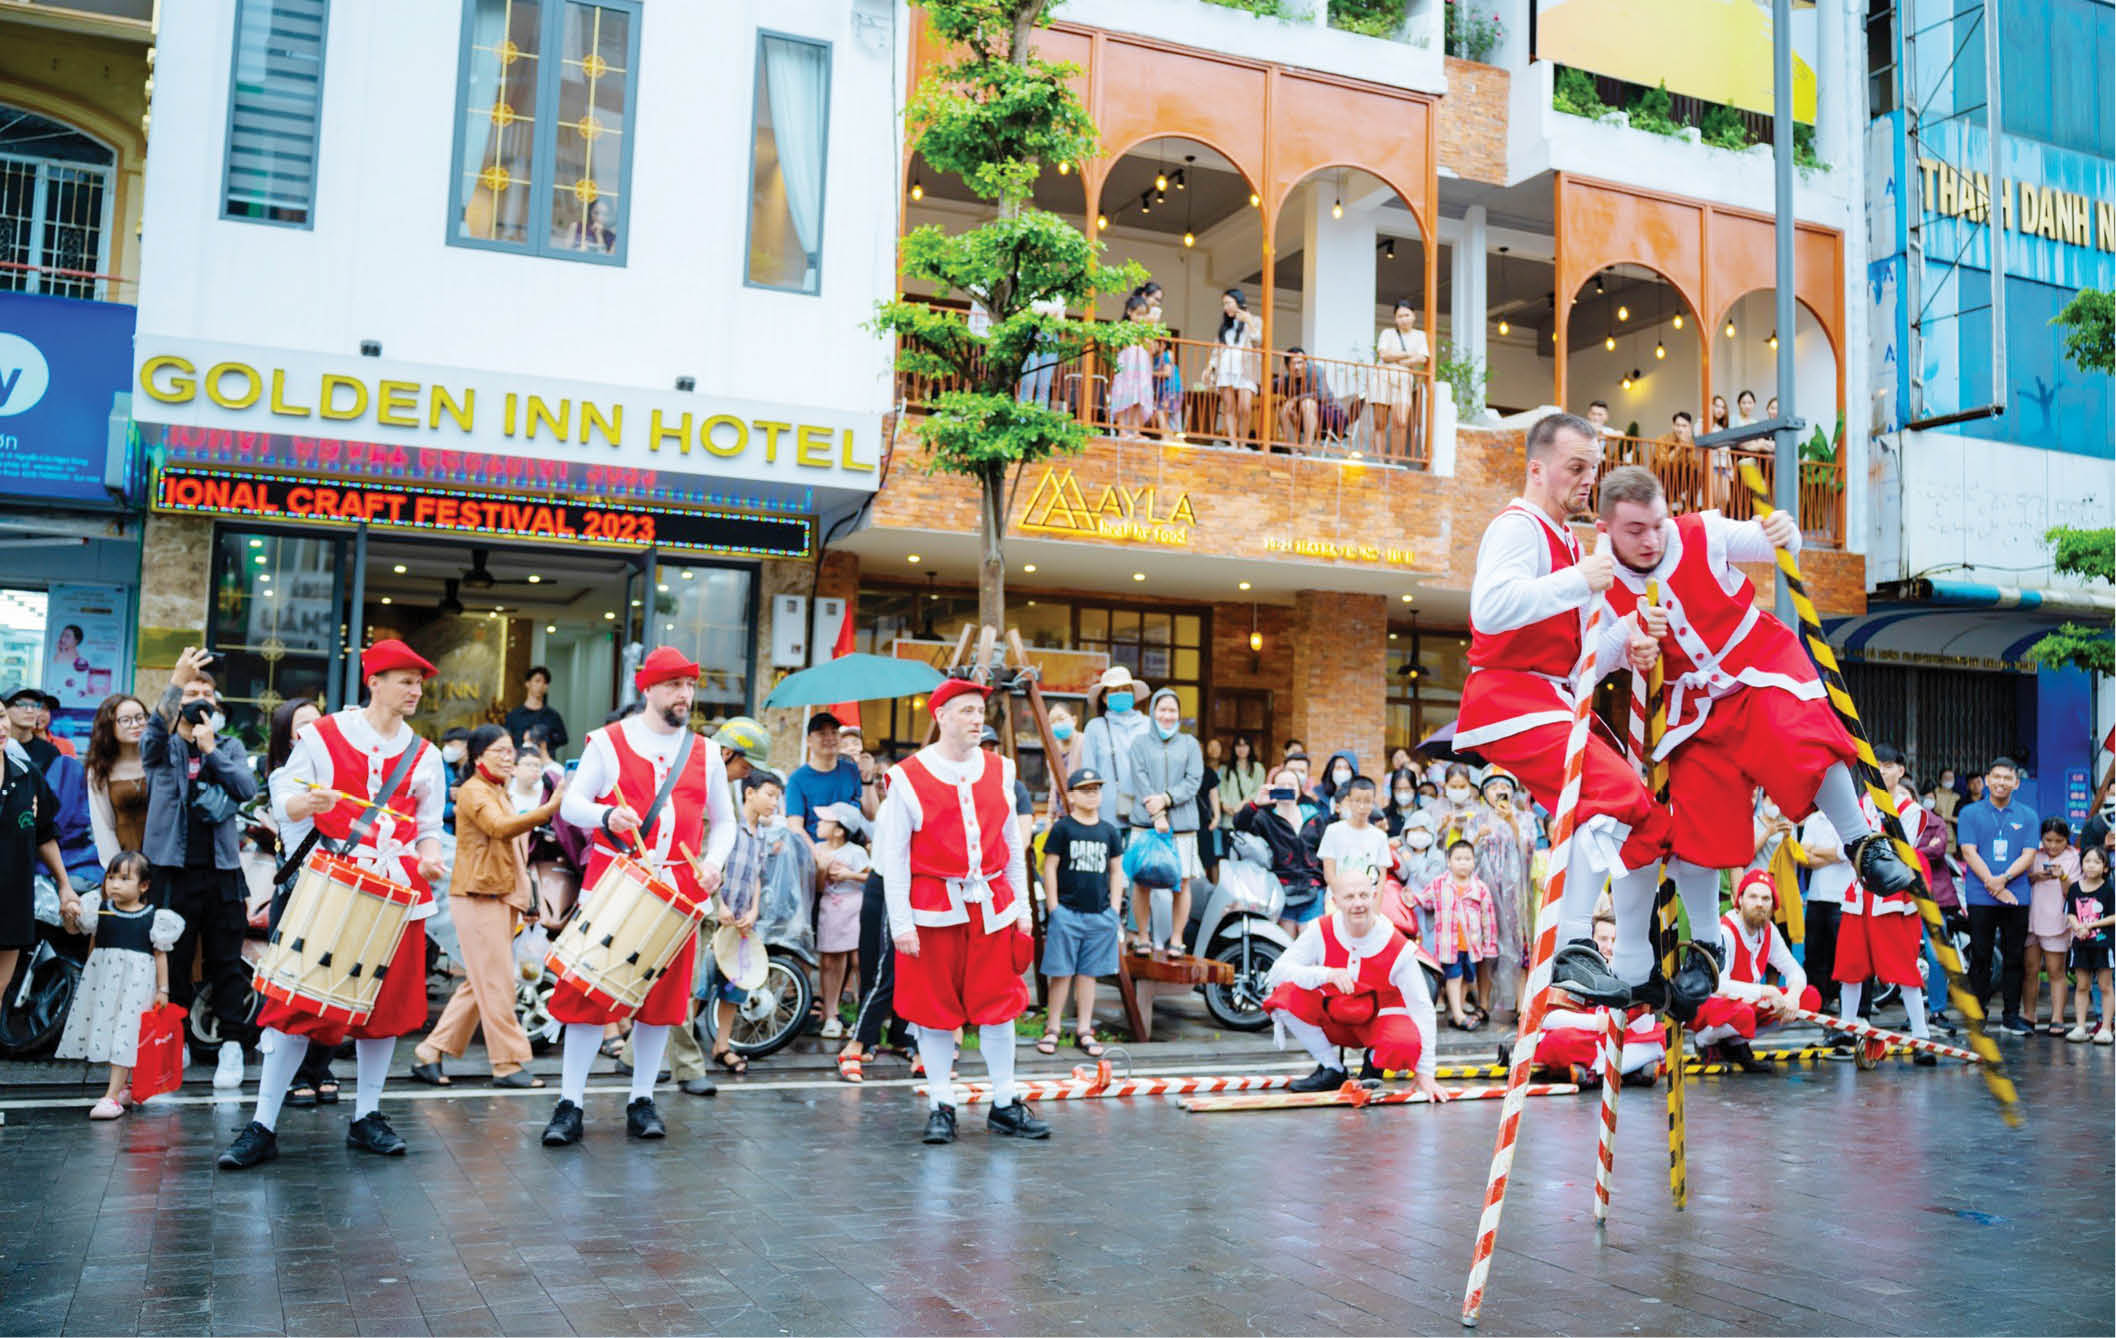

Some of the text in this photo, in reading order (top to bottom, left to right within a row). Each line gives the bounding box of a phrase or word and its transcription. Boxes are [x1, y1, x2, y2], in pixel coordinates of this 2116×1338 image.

[2018, 181, 2090, 247] DANH
[140, 355, 875, 473] GOLDEN INN HOTEL
[165, 476, 656, 541] IONAL CRAFT FESTIVAL 2023
